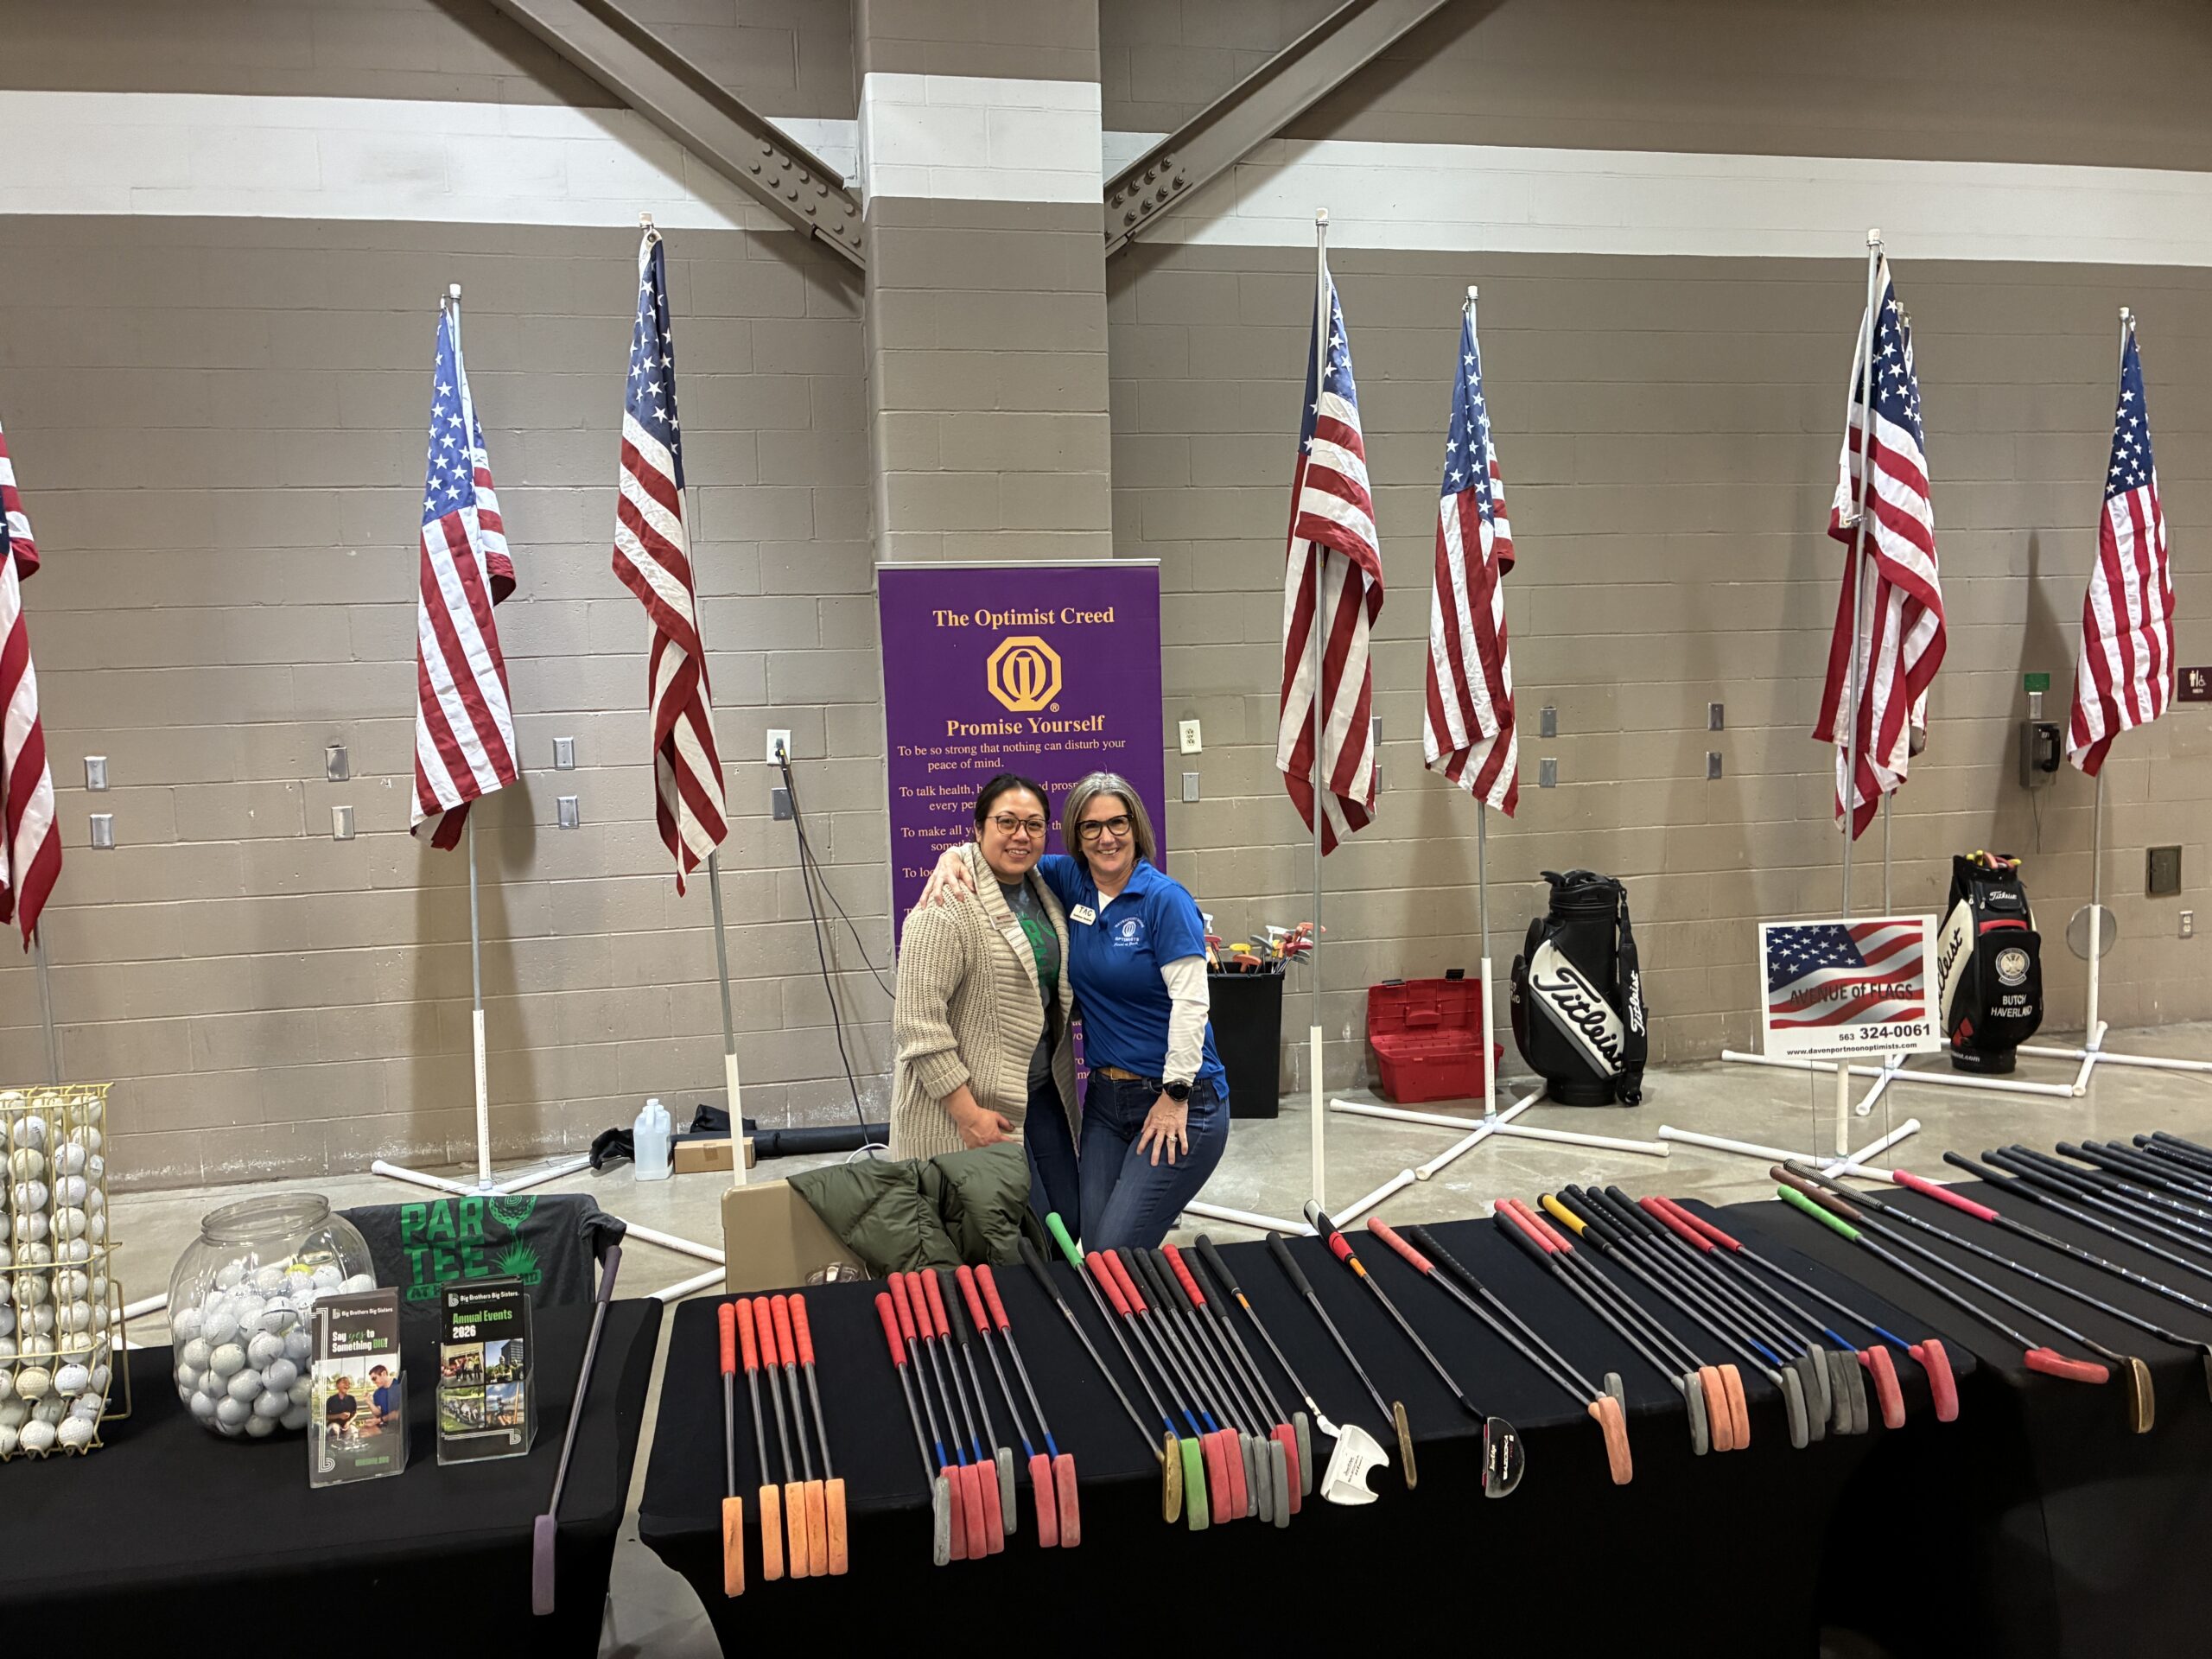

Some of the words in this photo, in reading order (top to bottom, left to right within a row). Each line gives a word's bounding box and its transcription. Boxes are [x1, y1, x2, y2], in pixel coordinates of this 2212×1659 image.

[933, 609, 969, 626] The
[975, 607, 1056, 630] Optimist
[1060, 607, 1115, 625] Creed
[946, 718, 1023, 736] Promise
[1027, 715, 1106, 734] Yourself
[898, 746, 912, 756] To
[914, 745, 927, 755] be
[931, 747, 943, 755] so
[945, 746, 977, 756] strong
[980, 743, 1000, 753] that
[1003, 741, 1042, 753] nothing
[1044, 742, 1062, 751] can
[1065, 739, 1100, 750] disturb
[1103, 740, 1127, 751] your
[928, 761, 958, 773] peace
[960, 759, 973, 768] of
[975, 758, 1005, 768] mind.
[899, 787, 913, 797] To
[916, 785, 936, 796] talk
[939, 785, 975, 796] health,
[929, 802, 958, 812] every
[900, 828, 915, 837] To
[918, 826, 947, 836] make
[949, 824, 962, 836] all
[902, 868, 917, 879] To
[1790, 984, 1848, 1005] AVENUE
[1851, 982, 1866, 998] of
[1870, 982, 1913, 1001] FLAGS
[2002, 995, 2027, 1006] BUTCH
[1628, 969, 1645, 1037] Titleist
[1533, 967, 1624, 1071] Titleist
[1839, 1033, 1855, 1041] 563
[1859, 1024, 1930, 1039] 324-0061
[1787, 1042, 1917, 1056] www.davenportnoonoptimists.com
[401, 1196, 484, 1245] PAR
[404, 1236, 489, 1286] TEE
[460, 1294, 469, 1303] Big
[453, 1310, 482, 1325] Annual
[484, 1309, 512, 1321] Events
[332, 1332, 346, 1342] Say
[366, 1329, 375, 1338] to
[453, 1325, 476, 1338] 2026
[332, 1341, 372, 1353] Something
